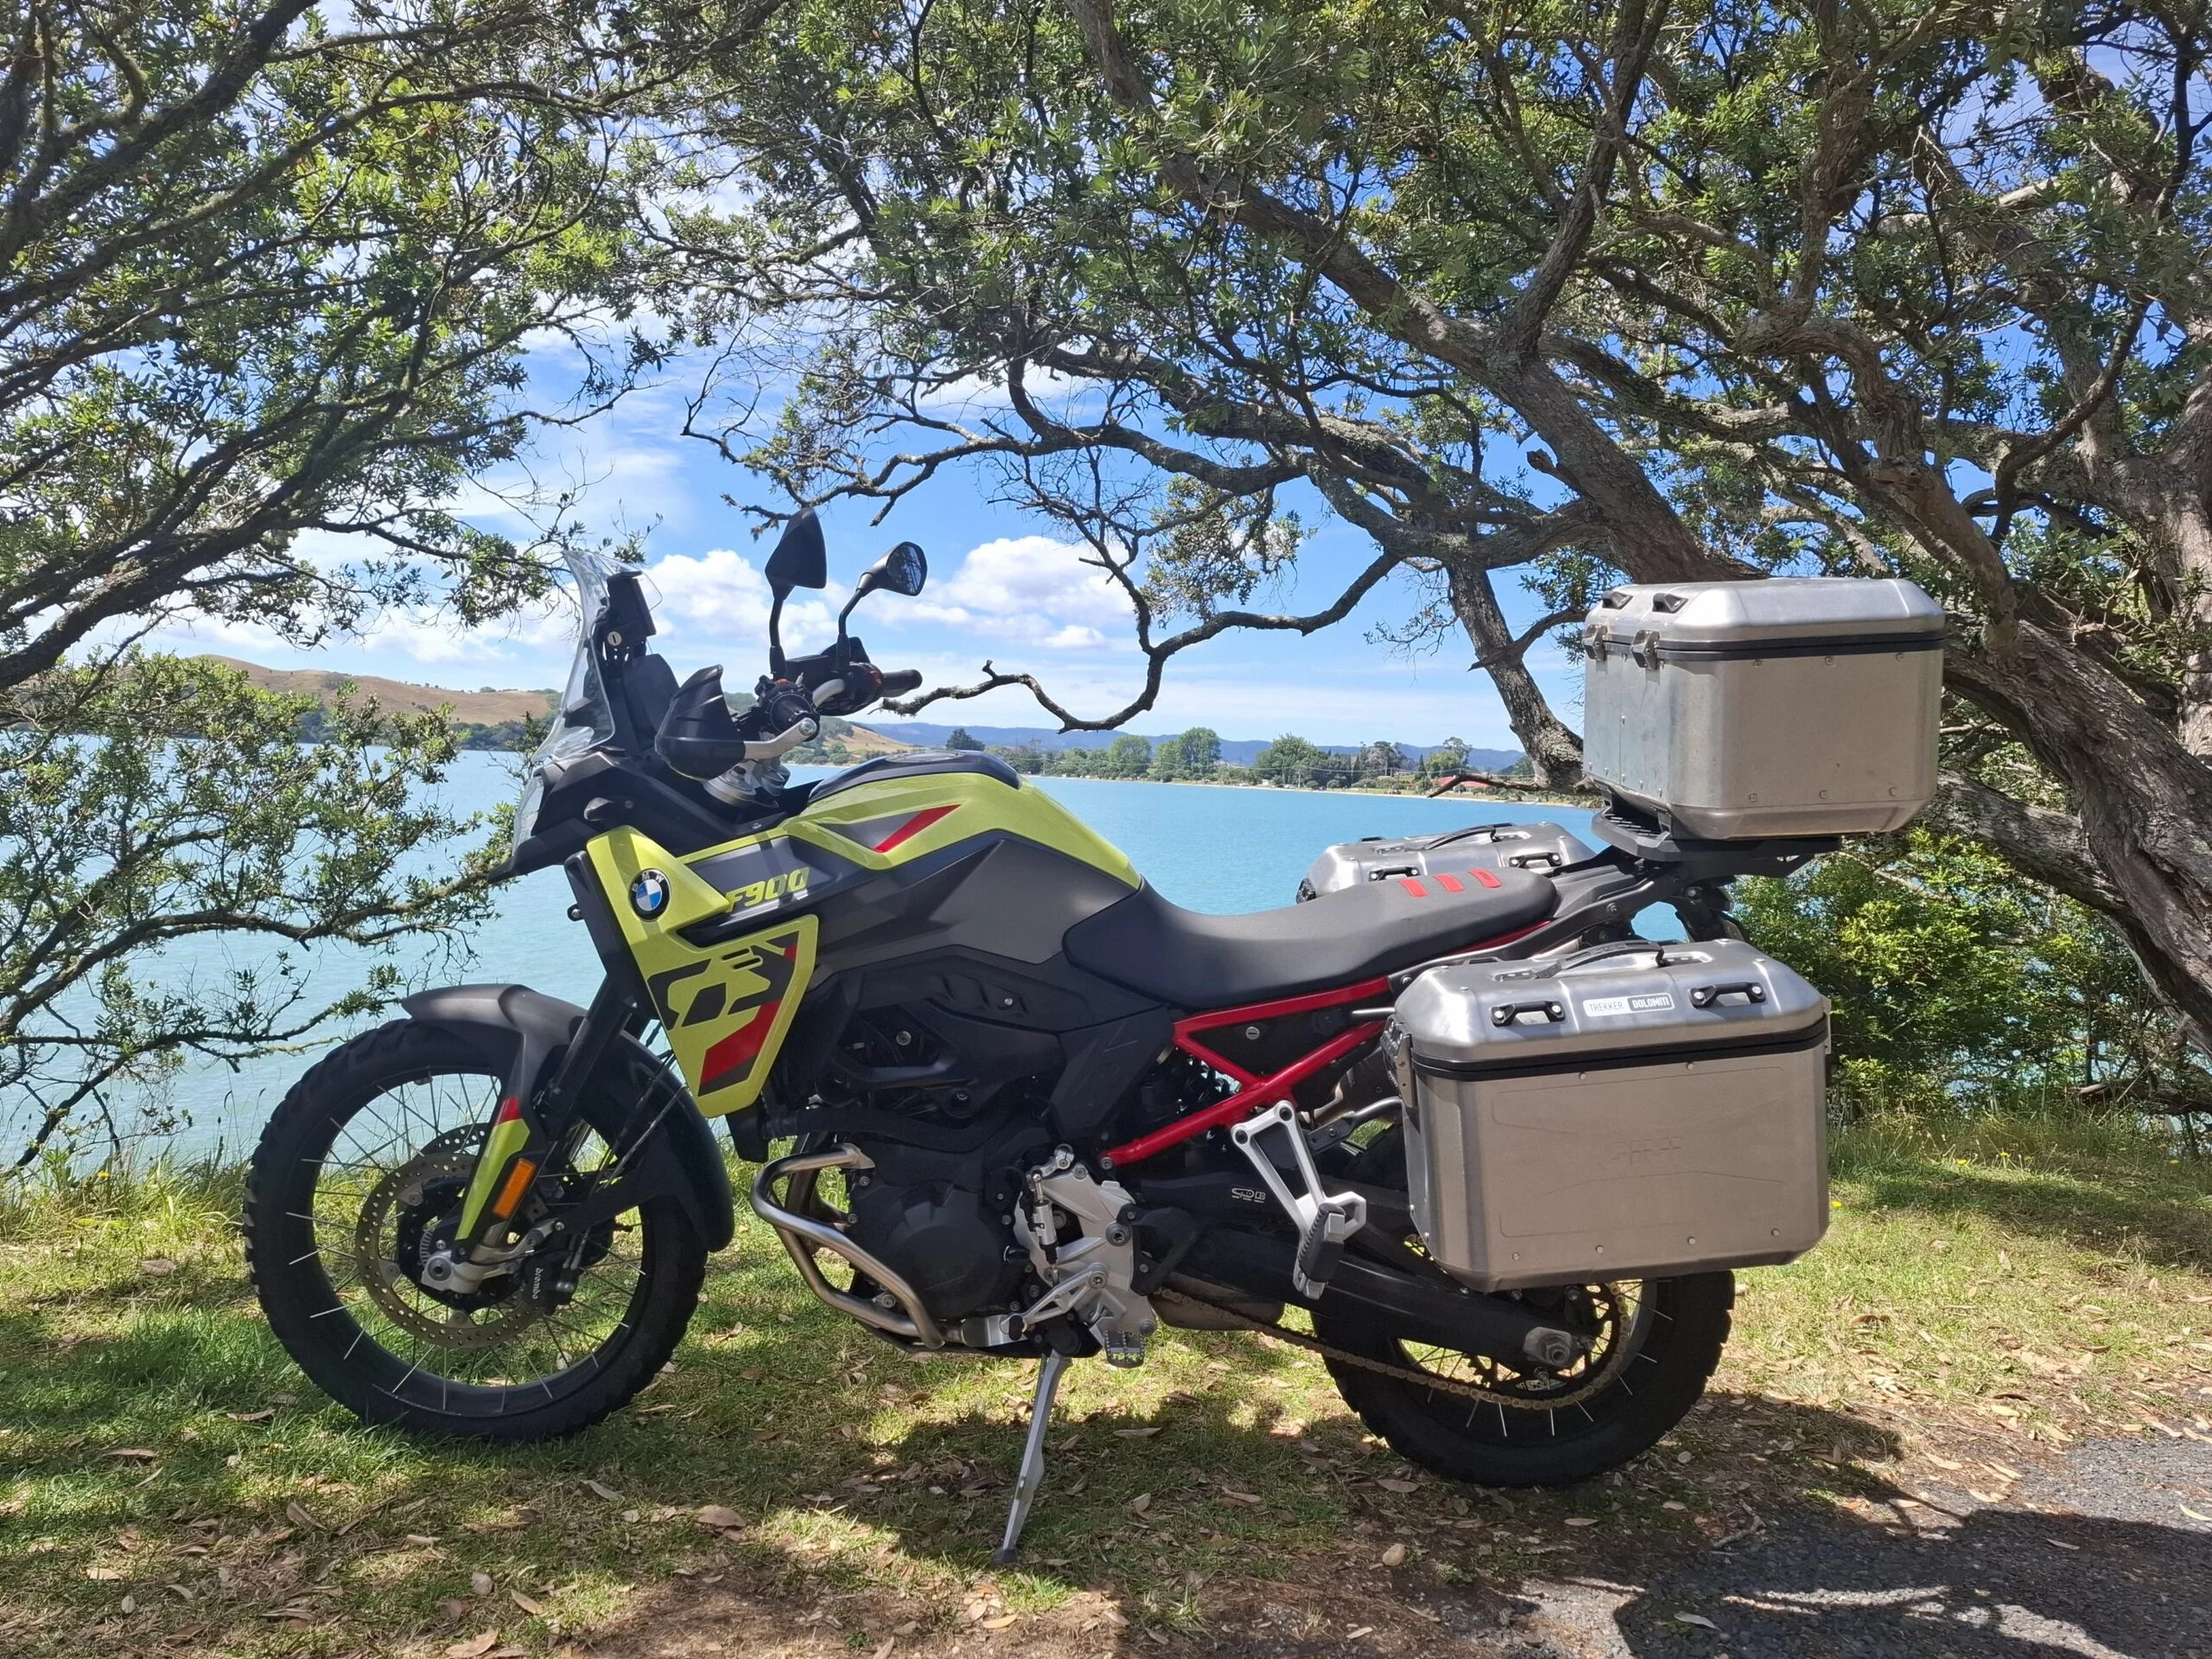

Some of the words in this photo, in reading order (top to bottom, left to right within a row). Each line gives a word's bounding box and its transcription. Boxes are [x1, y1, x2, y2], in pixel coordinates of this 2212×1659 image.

[632, 871, 664, 892] BMW
[726, 866, 810, 912] F900
[1589, 1000, 1624, 1012] TREKKER
[532, 1267, 544, 1300] brembo
